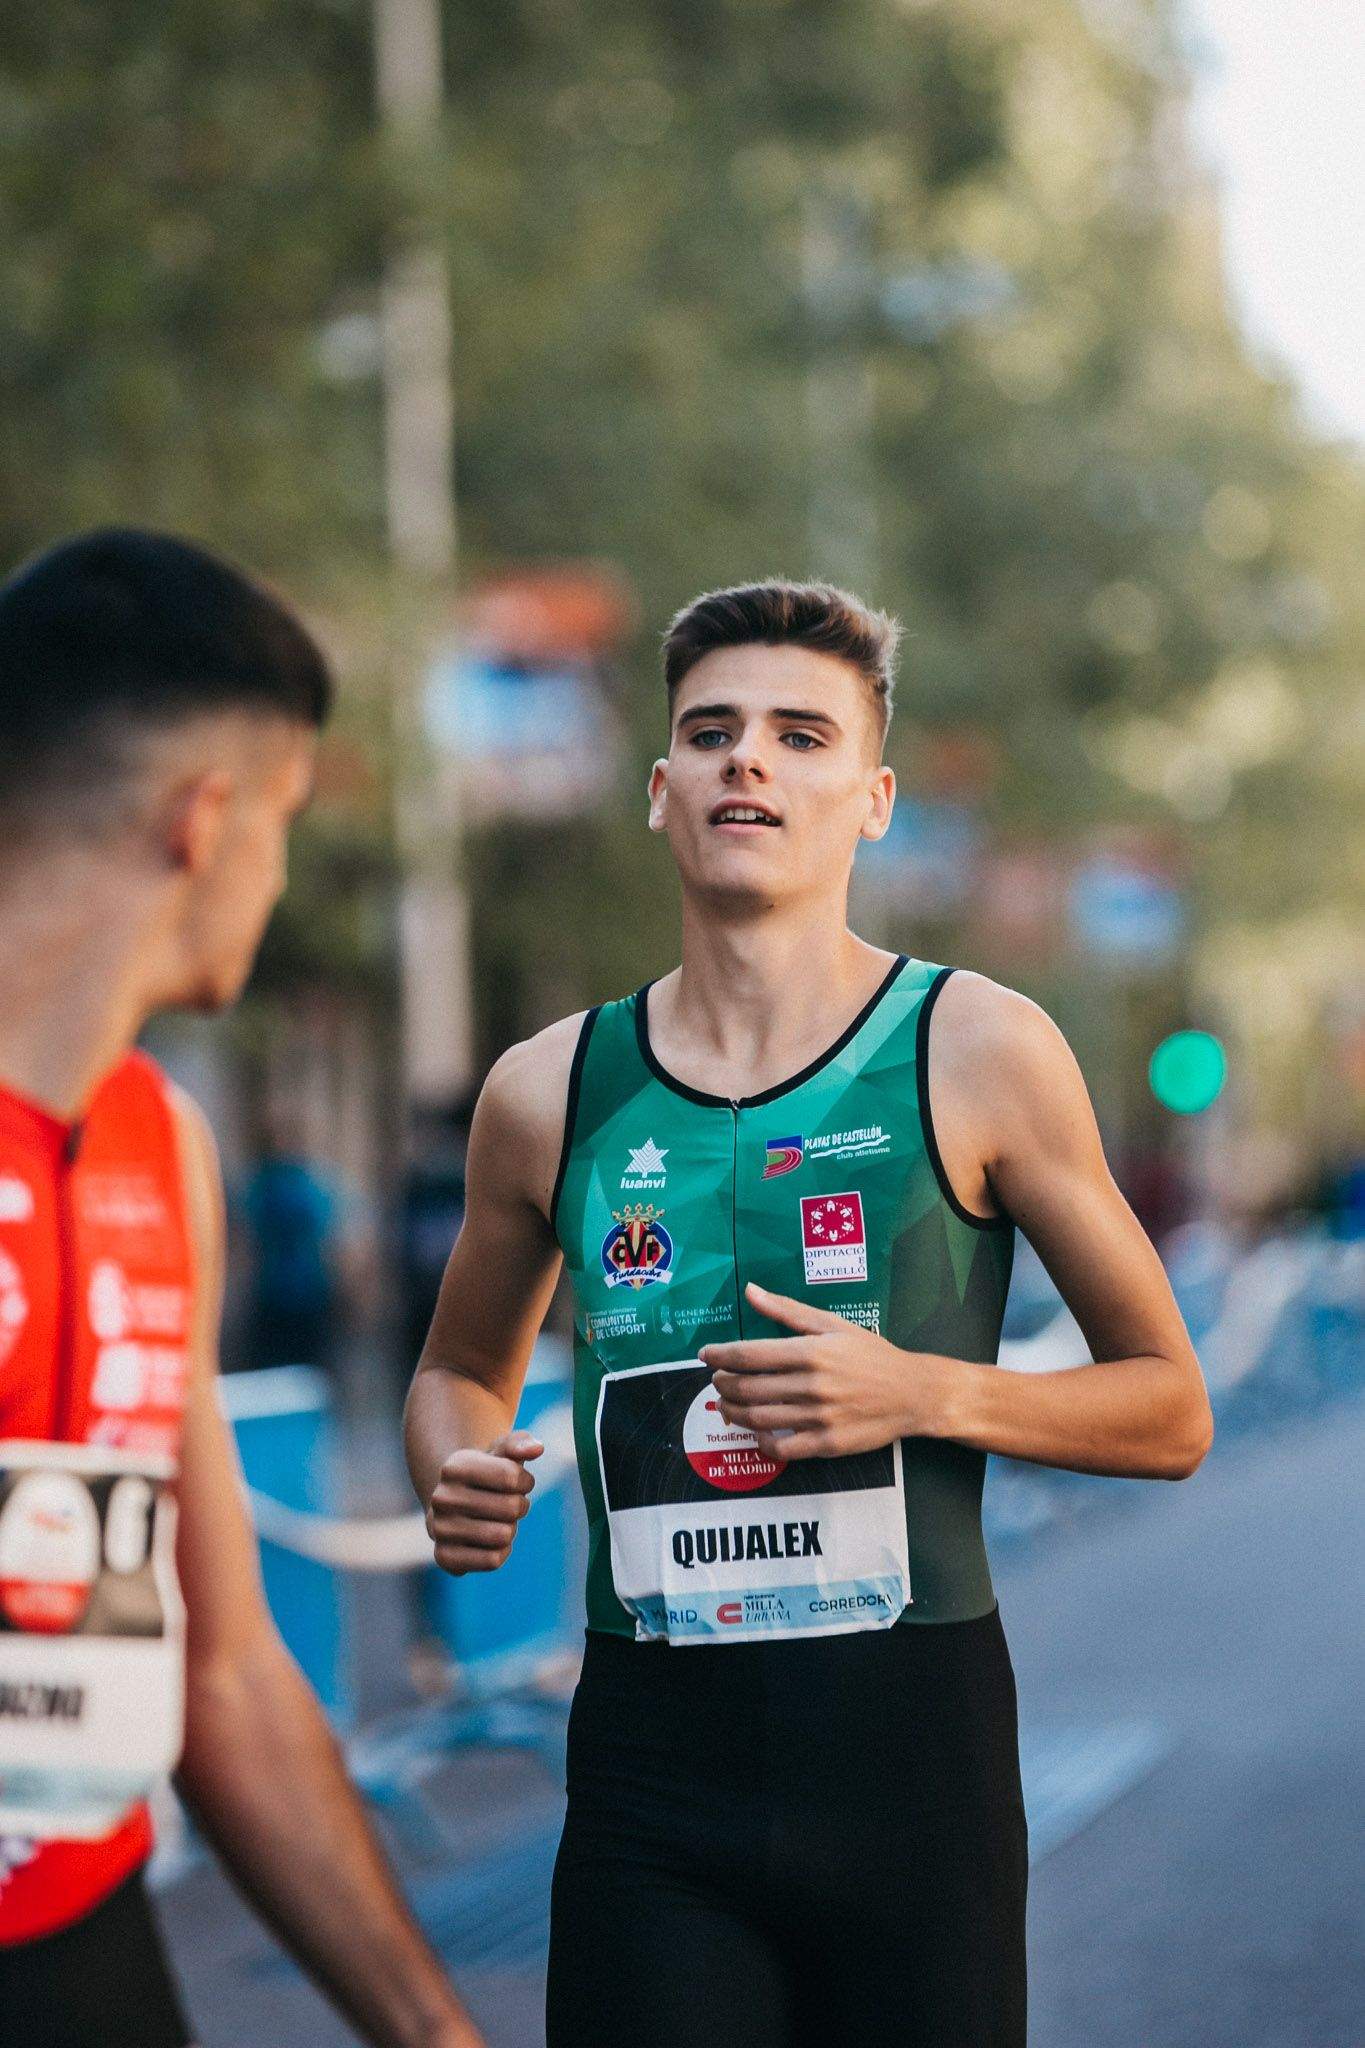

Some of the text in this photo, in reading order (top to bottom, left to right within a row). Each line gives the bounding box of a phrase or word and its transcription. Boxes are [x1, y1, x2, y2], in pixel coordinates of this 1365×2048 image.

[804, 1123, 882, 1150] PLAYAS DE CASTELLÓN
[836, 1151, 854, 1160] club
[620, 1176, 667, 1189] luanvi
[674, 1304, 733, 1318] GENERALITAT
[835, 1308, 880, 1320] RINIDAD
[590, 1313, 637, 1330] COMUNITAT
[676, 1313, 733, 1326] VALENCIANA
[595, 1329, 606, 1341] DE
[723, 1452, 760, 1464] MILLA
[709, 1463, 777, 1478] DE MADRID
[672, 1521, 823, 1569] QUIJALEX
[745, 1599, 785, 1611] MILLA
[746, 1610, 791, 1623] URBANA
